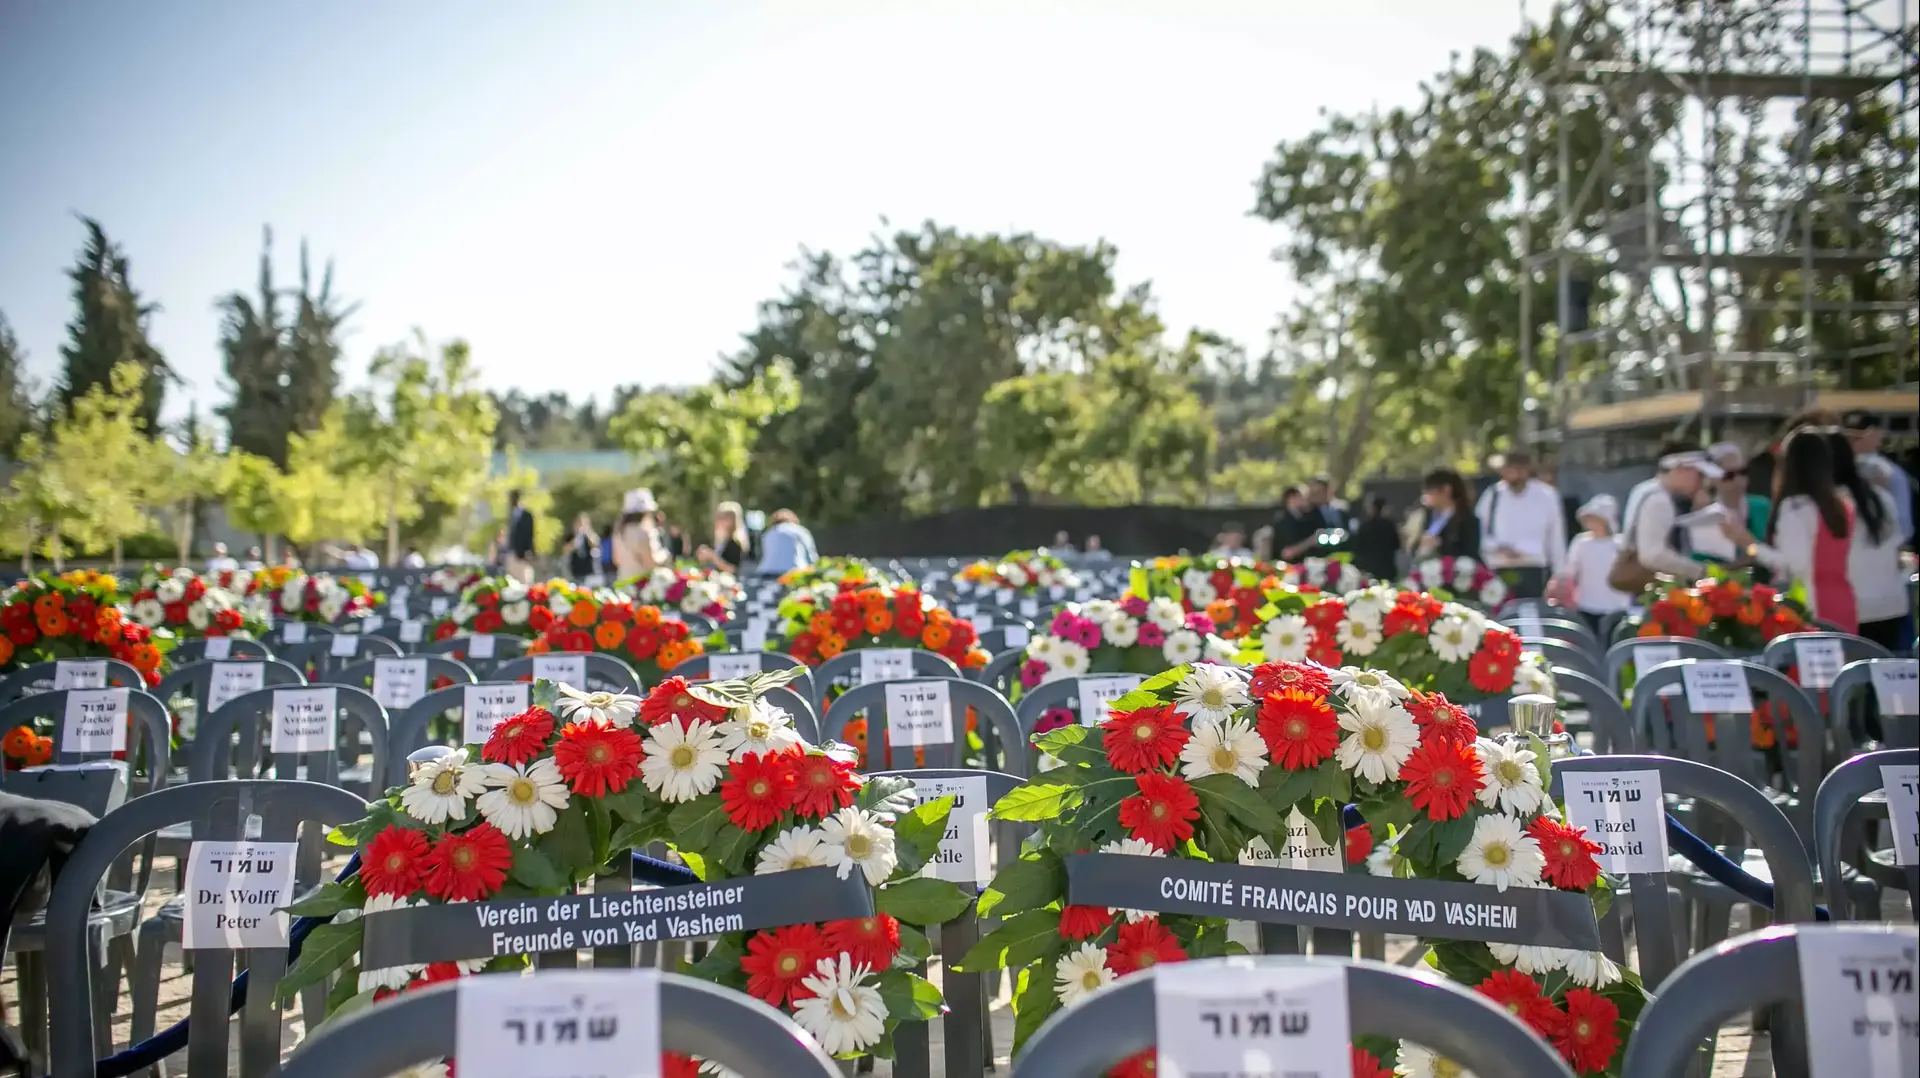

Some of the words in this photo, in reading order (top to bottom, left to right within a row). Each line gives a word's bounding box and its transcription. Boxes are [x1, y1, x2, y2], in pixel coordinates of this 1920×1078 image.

[1583, 788, 1642, 803] שמור
[1286, 822, 1309, 838] azi
[1594, 818, 1636, 833] Fazel
[1246, 844, 1336, 861] Jea-Pierre
[210, 859, 274, 874] שמור
[197, 889, 224, 905] Dr.
[229, 889, 280, 905] Wolff
[1160, 875, 1234, 906] COMITÉ
[1241, 885, 1338, 916] FRANCAIS
[1345, 894, 1398, 921] POUR
[1404, 899, 1436, 923] YAD
[1444, 901, 1518, 929] VASHEM
[476, 902, 538, 928] Verein
[547, 900, 581, 922] der
[589, 885, 745, 919] Liechtensteiner
[216, 912, 261, 929] Peter
[492, 926, 575, 956] Freunde
[581, 927, 619, 947] von
[622, 920, 658, 943] Yad
[665, 912, 744, 939] Vashem
[1841, 968, 1914, 995] מור
[503, 1015, 619, 1045] שמור
[1200, 1011, 1310, 1038] שמור
